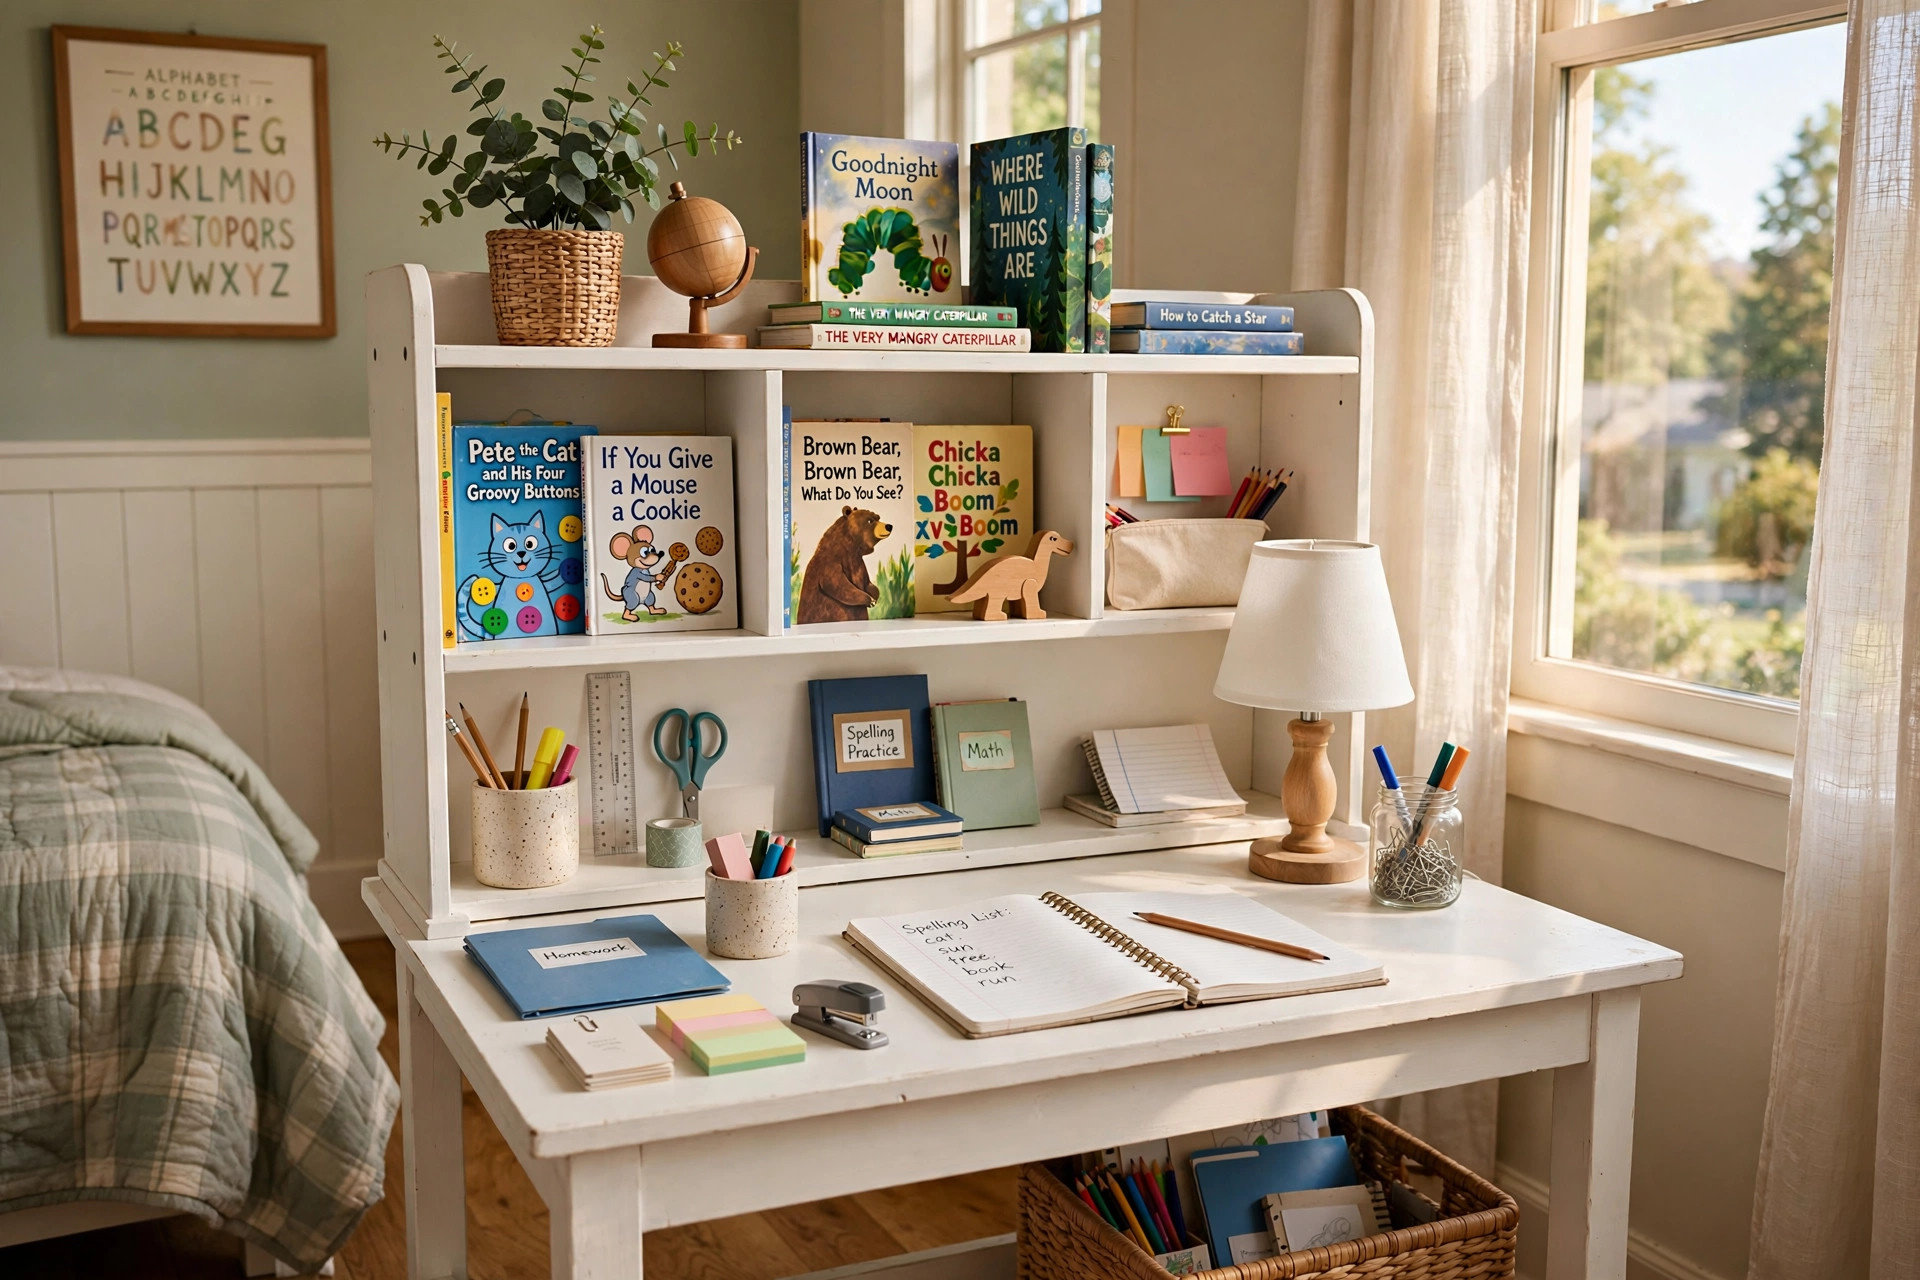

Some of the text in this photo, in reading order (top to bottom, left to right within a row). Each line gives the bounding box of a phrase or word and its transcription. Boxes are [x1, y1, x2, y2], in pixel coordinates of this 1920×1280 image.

[145, 68, 241, 87] ALPHABET
[831, 150, 938, 183] Goodnight
[991, 152, 1044, 186] WHERE
[854, 177, 914, 202] Moon
[999, 186, 1038, 217] WILD
[989, 217, 1048, 250] THINGS
[1003, 251, 1035, 280] ARE
[848, 307, 866, 320] THE
[1160, 308, 1267, 325] How to Catch a Star
[825, 330, 849, 343] THE
[852, 331, 884, 344] VERY
[942, 333, 1017, 346] CATERPILLAR
[468, 438, 578, 463] Pete the Cat
[601, 446, 714, 469] If You Give
[803, 435, 902, 458] Brown Bear,
[928, 439, 1001, 463] Chicka
[482, 467, 566, 482] and His Four
[804, 460, 903, 482] Brown Bear,
[928, 464, 1001, 488] Chicka
[466, 482, 580, 504] Groovy Buttons
[611, 472, 698, 495] a Mouse
[801, 484, 904, 501] What Do You See?
[612, 498, 701, 521] a Cookie
[934, 488, 995, 513] Boom
[960, 514, 1019, 537] Boom
[847, 724, 895, 745] Spelling
[848, 743, 901, 760] Practice
[967, 741, 1004, 759] Math
[902, 908, 1012, 935] Spelling List:
[543, 943, 630, 961] Homework
[938, 943, 974, 955] sun
[962, 961, 1014, 976] book
[977, 975, 1017, 987] run
